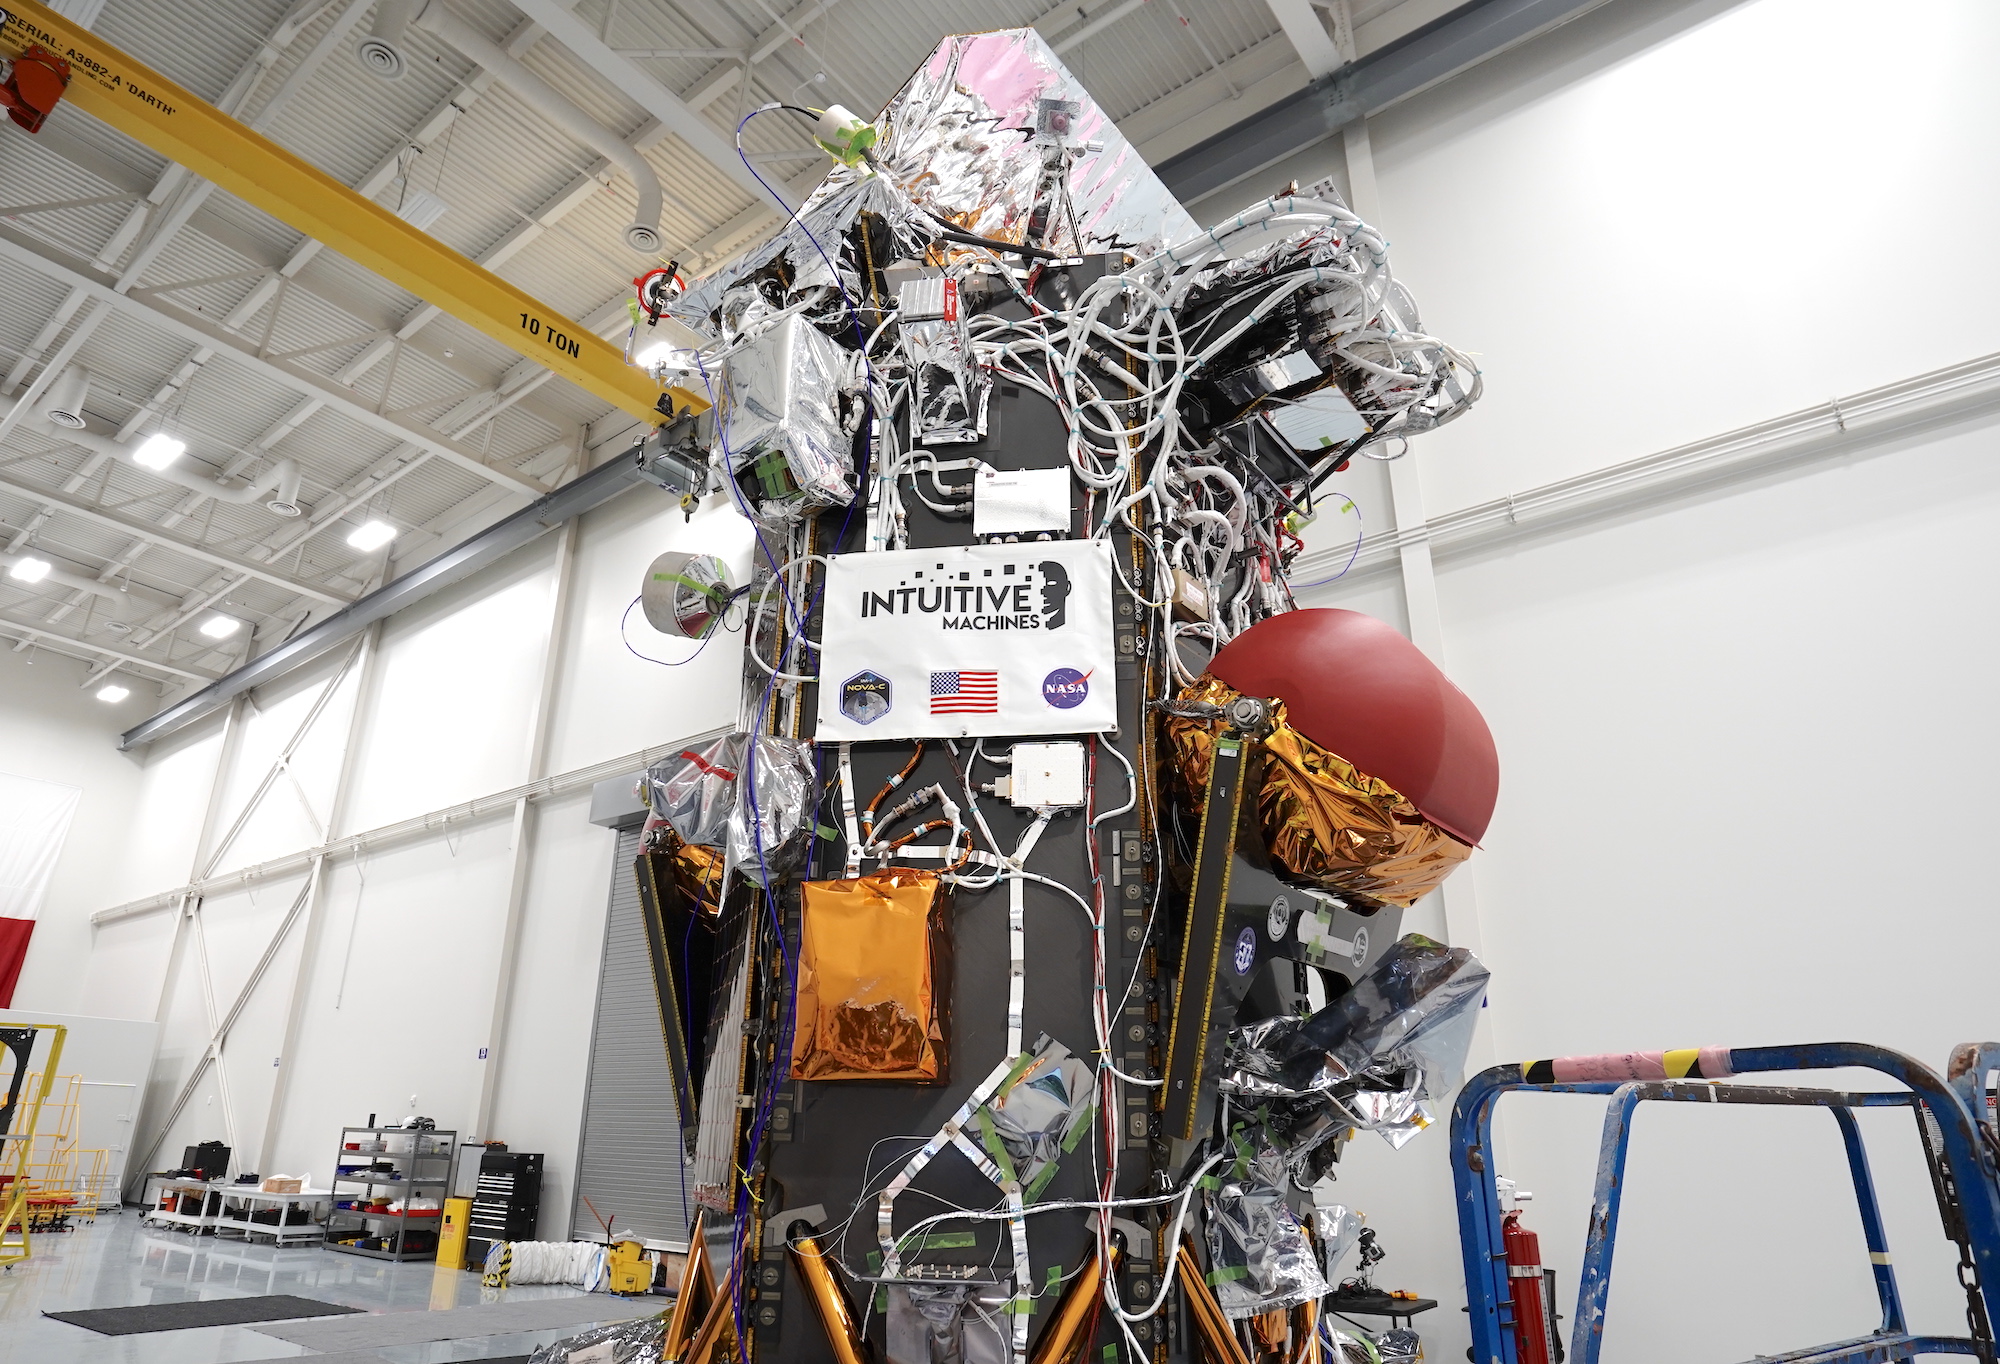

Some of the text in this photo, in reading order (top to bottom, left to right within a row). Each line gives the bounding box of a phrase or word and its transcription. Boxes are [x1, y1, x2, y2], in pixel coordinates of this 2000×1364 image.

[7, 13, 63, 51] SERIAL:
[66, 48, 120, 86] A3882-A
[520, 313, 580, 359] 10 TON
[861, 584, 1032, 618] INTUITIVE
[942, 614, 1040, 630] MACHINES
[846, 683, 886, 691] NOVA-C
[1046, 683, 1087, 694] NASA
